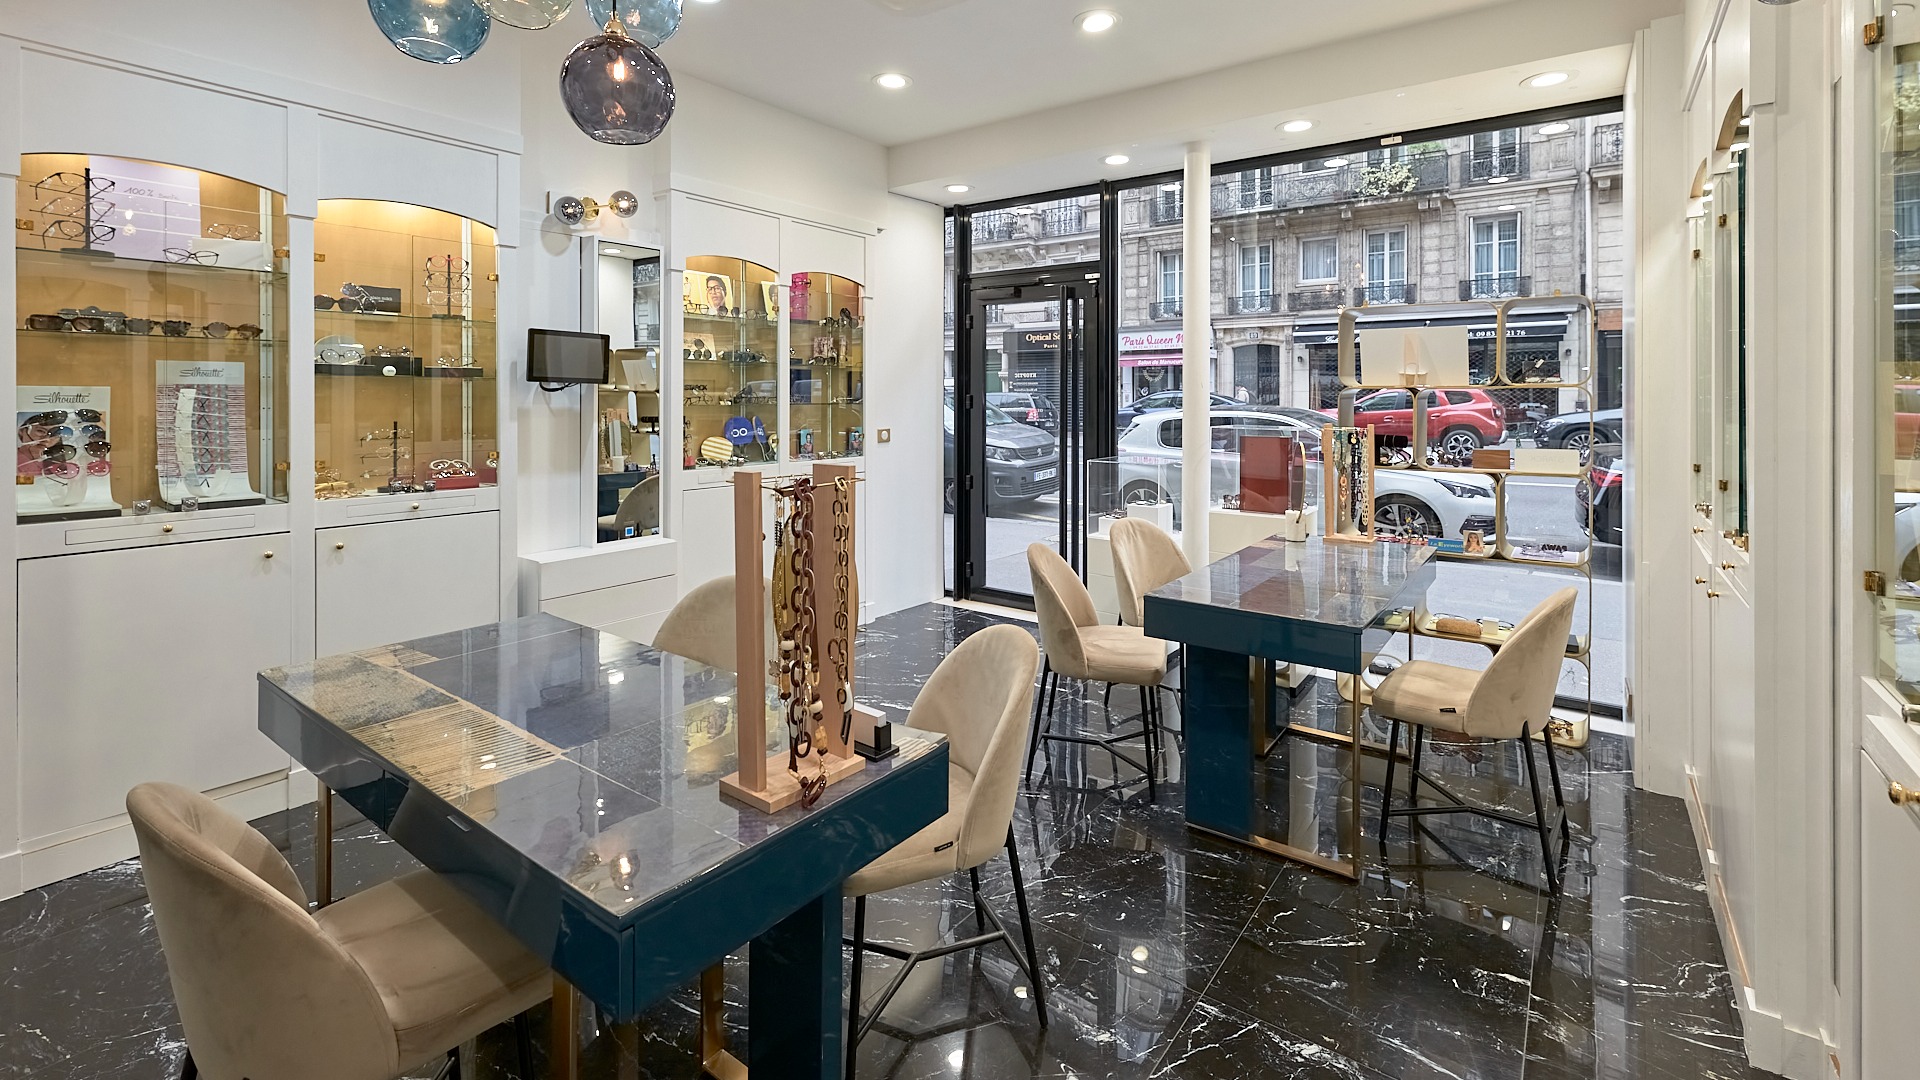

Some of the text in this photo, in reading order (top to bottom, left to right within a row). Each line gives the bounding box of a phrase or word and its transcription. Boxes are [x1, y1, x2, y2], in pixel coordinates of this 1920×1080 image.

[1025, 332, 1052, 344] Optical
[1122, 336, 1145, 346] Paris
[1146, 334, 1174, 345] Queen
[179, 366, 224, 378] Silhouette
[33, 391, 90, 404] Silhouette
